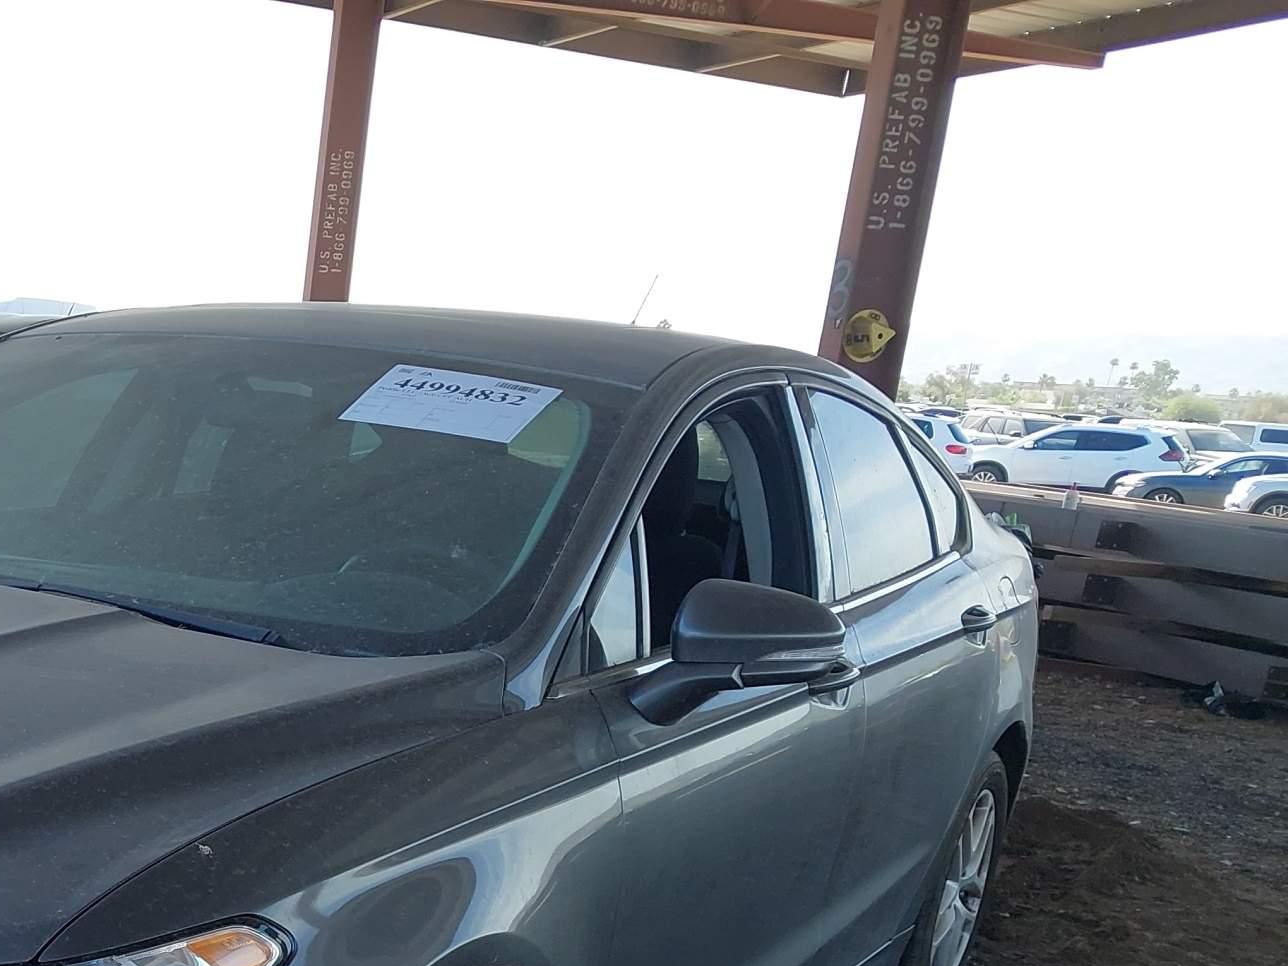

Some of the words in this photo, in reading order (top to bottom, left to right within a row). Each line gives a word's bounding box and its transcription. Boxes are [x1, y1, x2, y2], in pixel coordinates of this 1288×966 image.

[898, 12, 924, 59] INC.
[878, 73, 912, 169] PREFAB
[888, 15, 943, 229] 1-866-799-0969
[328, 148, 343, 176] INC.
[322, 183, 338, 239] PREFAB
[330, 150, 355, 273] 1-866-799-0969
[866, 184, 892, 230] U.S.
[318, 247, 332, 273] U.S.
[393, 378, 528, 407] 44994832
